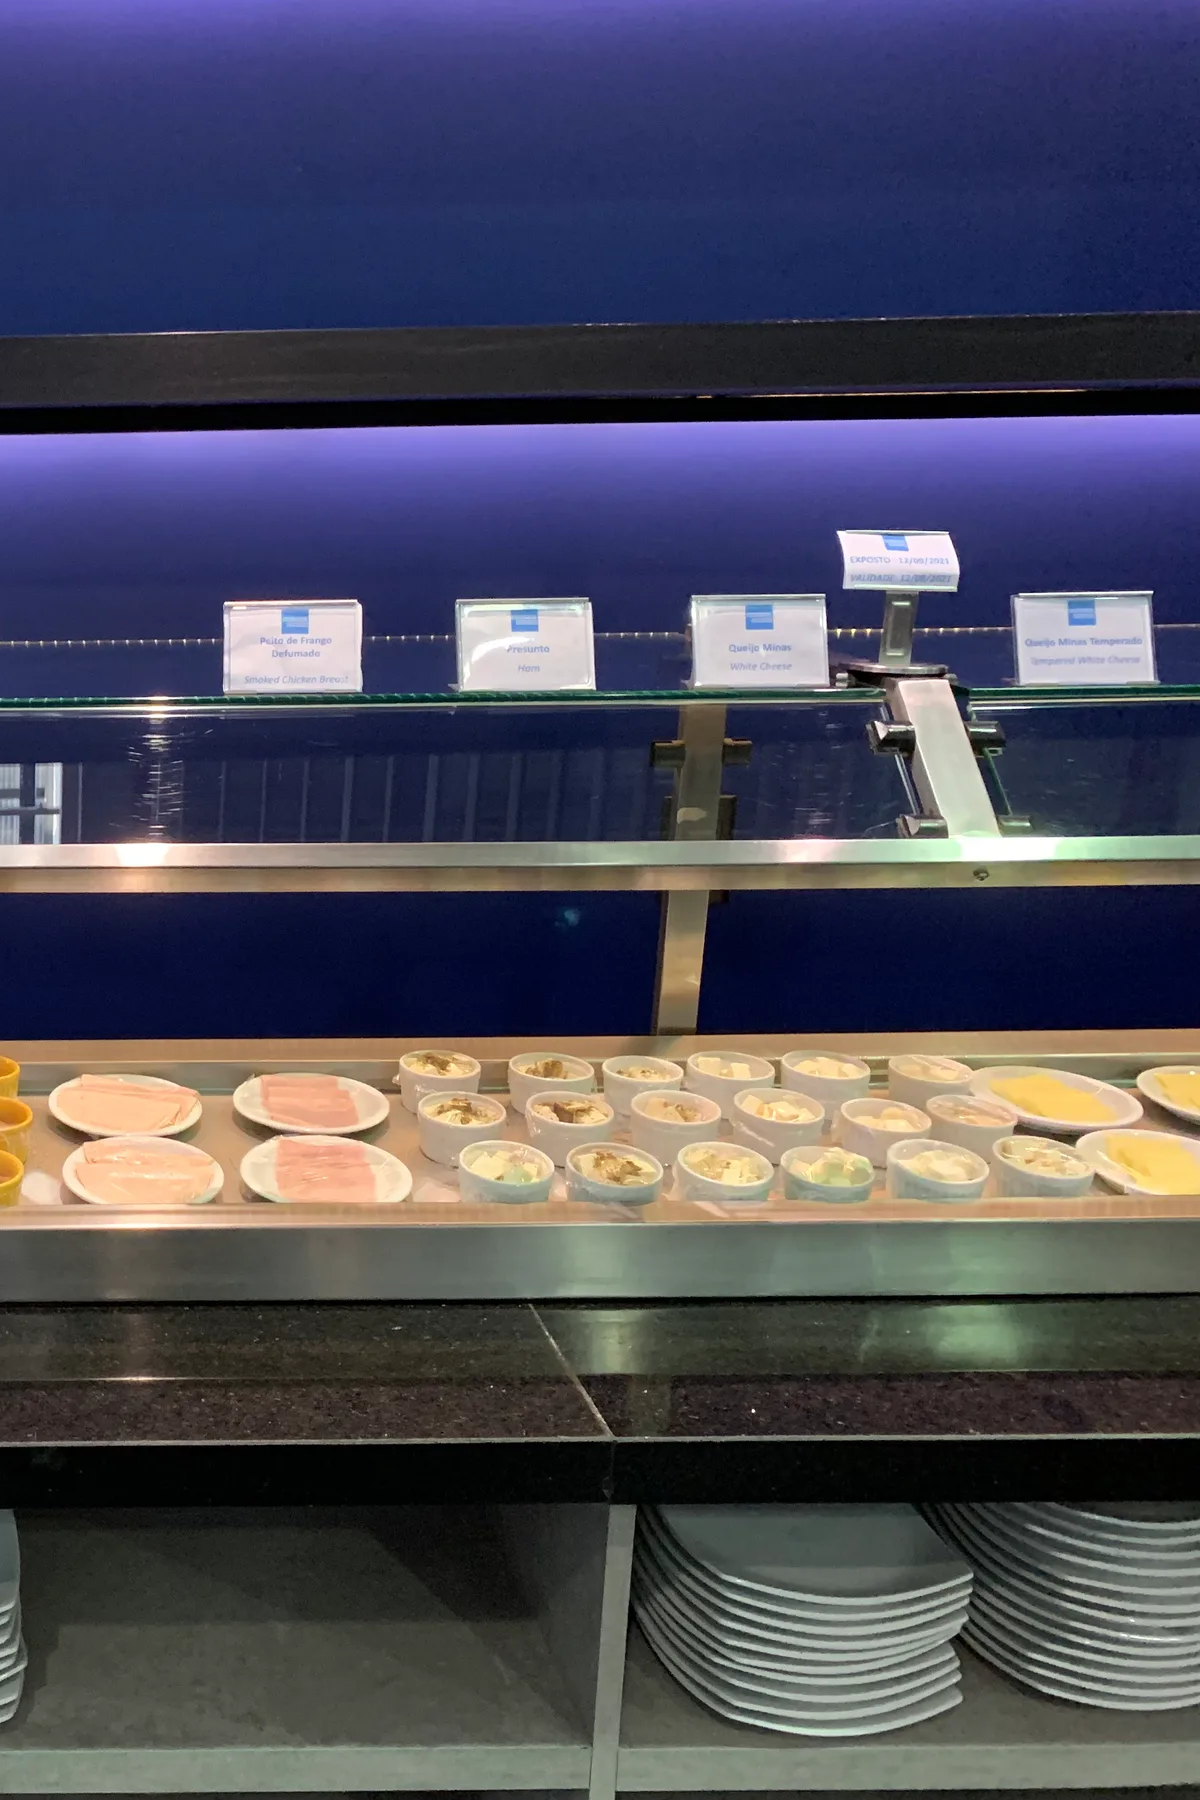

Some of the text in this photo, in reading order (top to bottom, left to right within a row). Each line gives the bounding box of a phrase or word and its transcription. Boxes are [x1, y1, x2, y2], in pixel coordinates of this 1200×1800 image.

[260, 636, 332, 646] Peito de Frango
[1024, 637, 1142, 648] Queijo Minas Temperado
[506, 645, 550, 654] Presunto
[728, 643, 792, 653] Queijo Minas
[272, 650, 320, 658] Defumado
[518, 664, 540, 673] Ham
[730, 662, 792, 671] White Cheese
[244, 676, 280, 684] Smoked
[282, 676, 316, 684] Chicken
